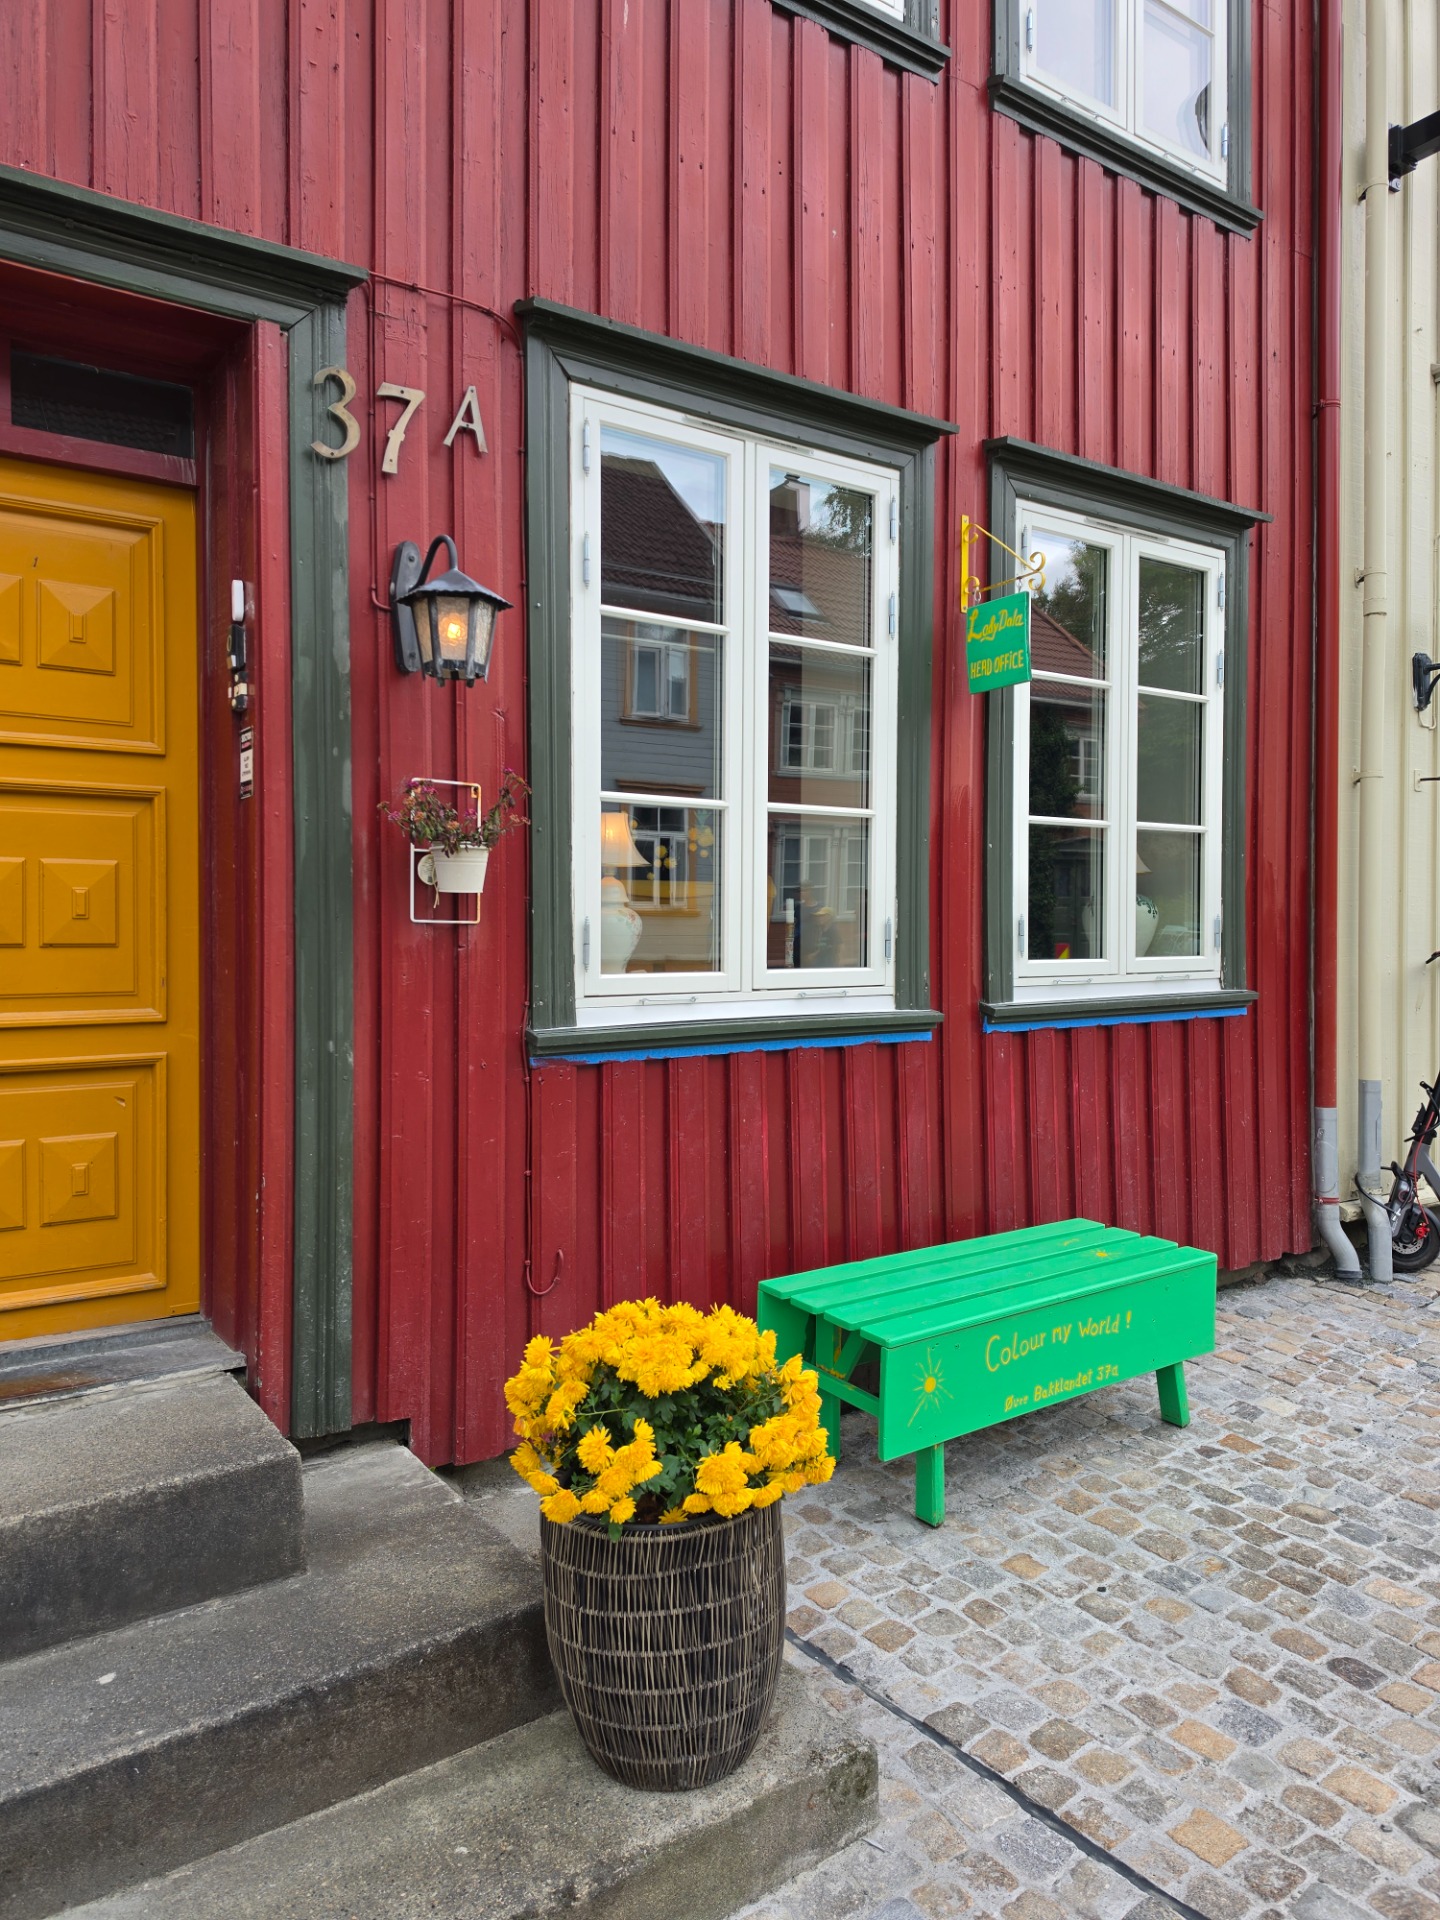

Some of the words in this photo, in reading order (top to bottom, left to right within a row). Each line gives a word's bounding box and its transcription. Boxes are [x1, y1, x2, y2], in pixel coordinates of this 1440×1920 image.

[970, 657, 993, 679] HEAD
[985, 1332, 1047, 1372] Colour
[1052, 1323, 1073, 1344] my
[1033, 1369, 1093, 1402] Bakklandet
[1096, 1364, 1119, 1381] 37a
